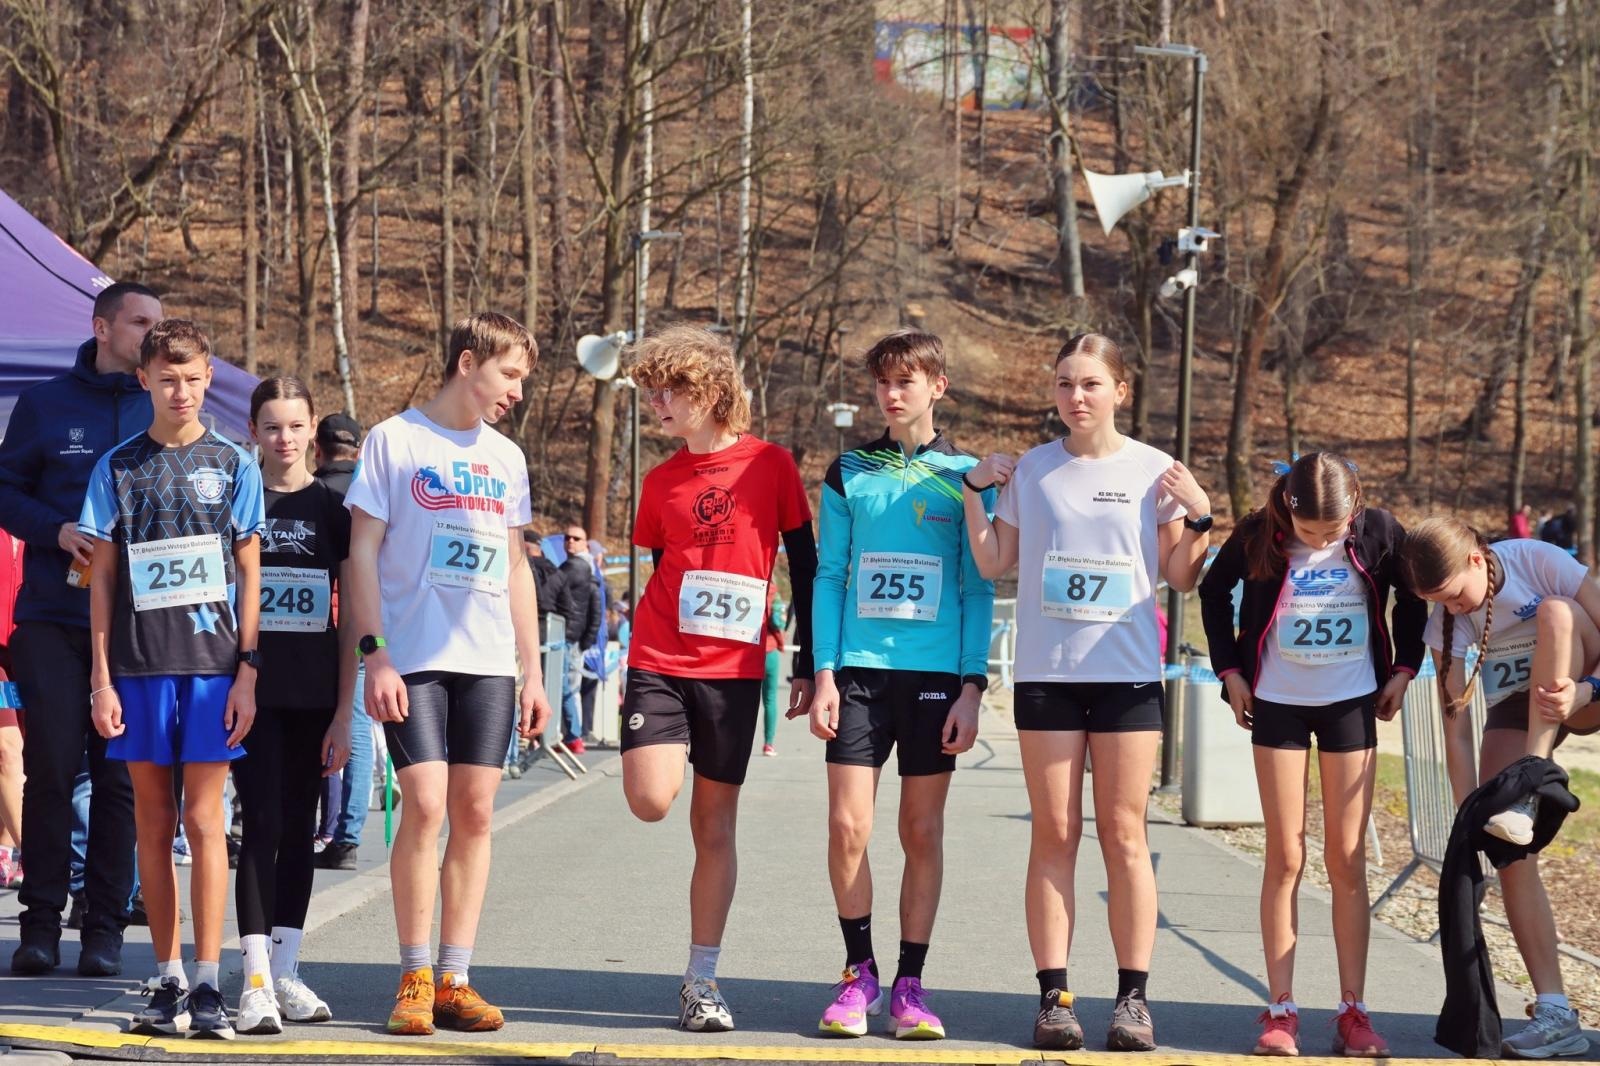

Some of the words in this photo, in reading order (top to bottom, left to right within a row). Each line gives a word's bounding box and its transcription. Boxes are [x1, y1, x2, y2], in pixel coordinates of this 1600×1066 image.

[452, 461, 472, 495] 5
[471, 463, 489, 476] UKS
[455, 495, 504, 515] RYDUŁTOW
[167, 542, 190, 550] Wstęga
[446, 540, 497, 573] 257
[147, 557, 208, 590] 254
[260, 571, 280, 579] ękitna
[280, 571, 301, 579] Wstęga
[870, 573, 925, 601] 255
[1067, 573, 1108, 602] 87
[1290, 567, 1349, 581] UKS
[260, 586, 314, 614] 248
[693, 590, 751, 622] 259
[1294, 618, 1352, 646] 252
[1509, 642, 1532, 651] Wstęga
[1493, 658, 1532, 688] 25
